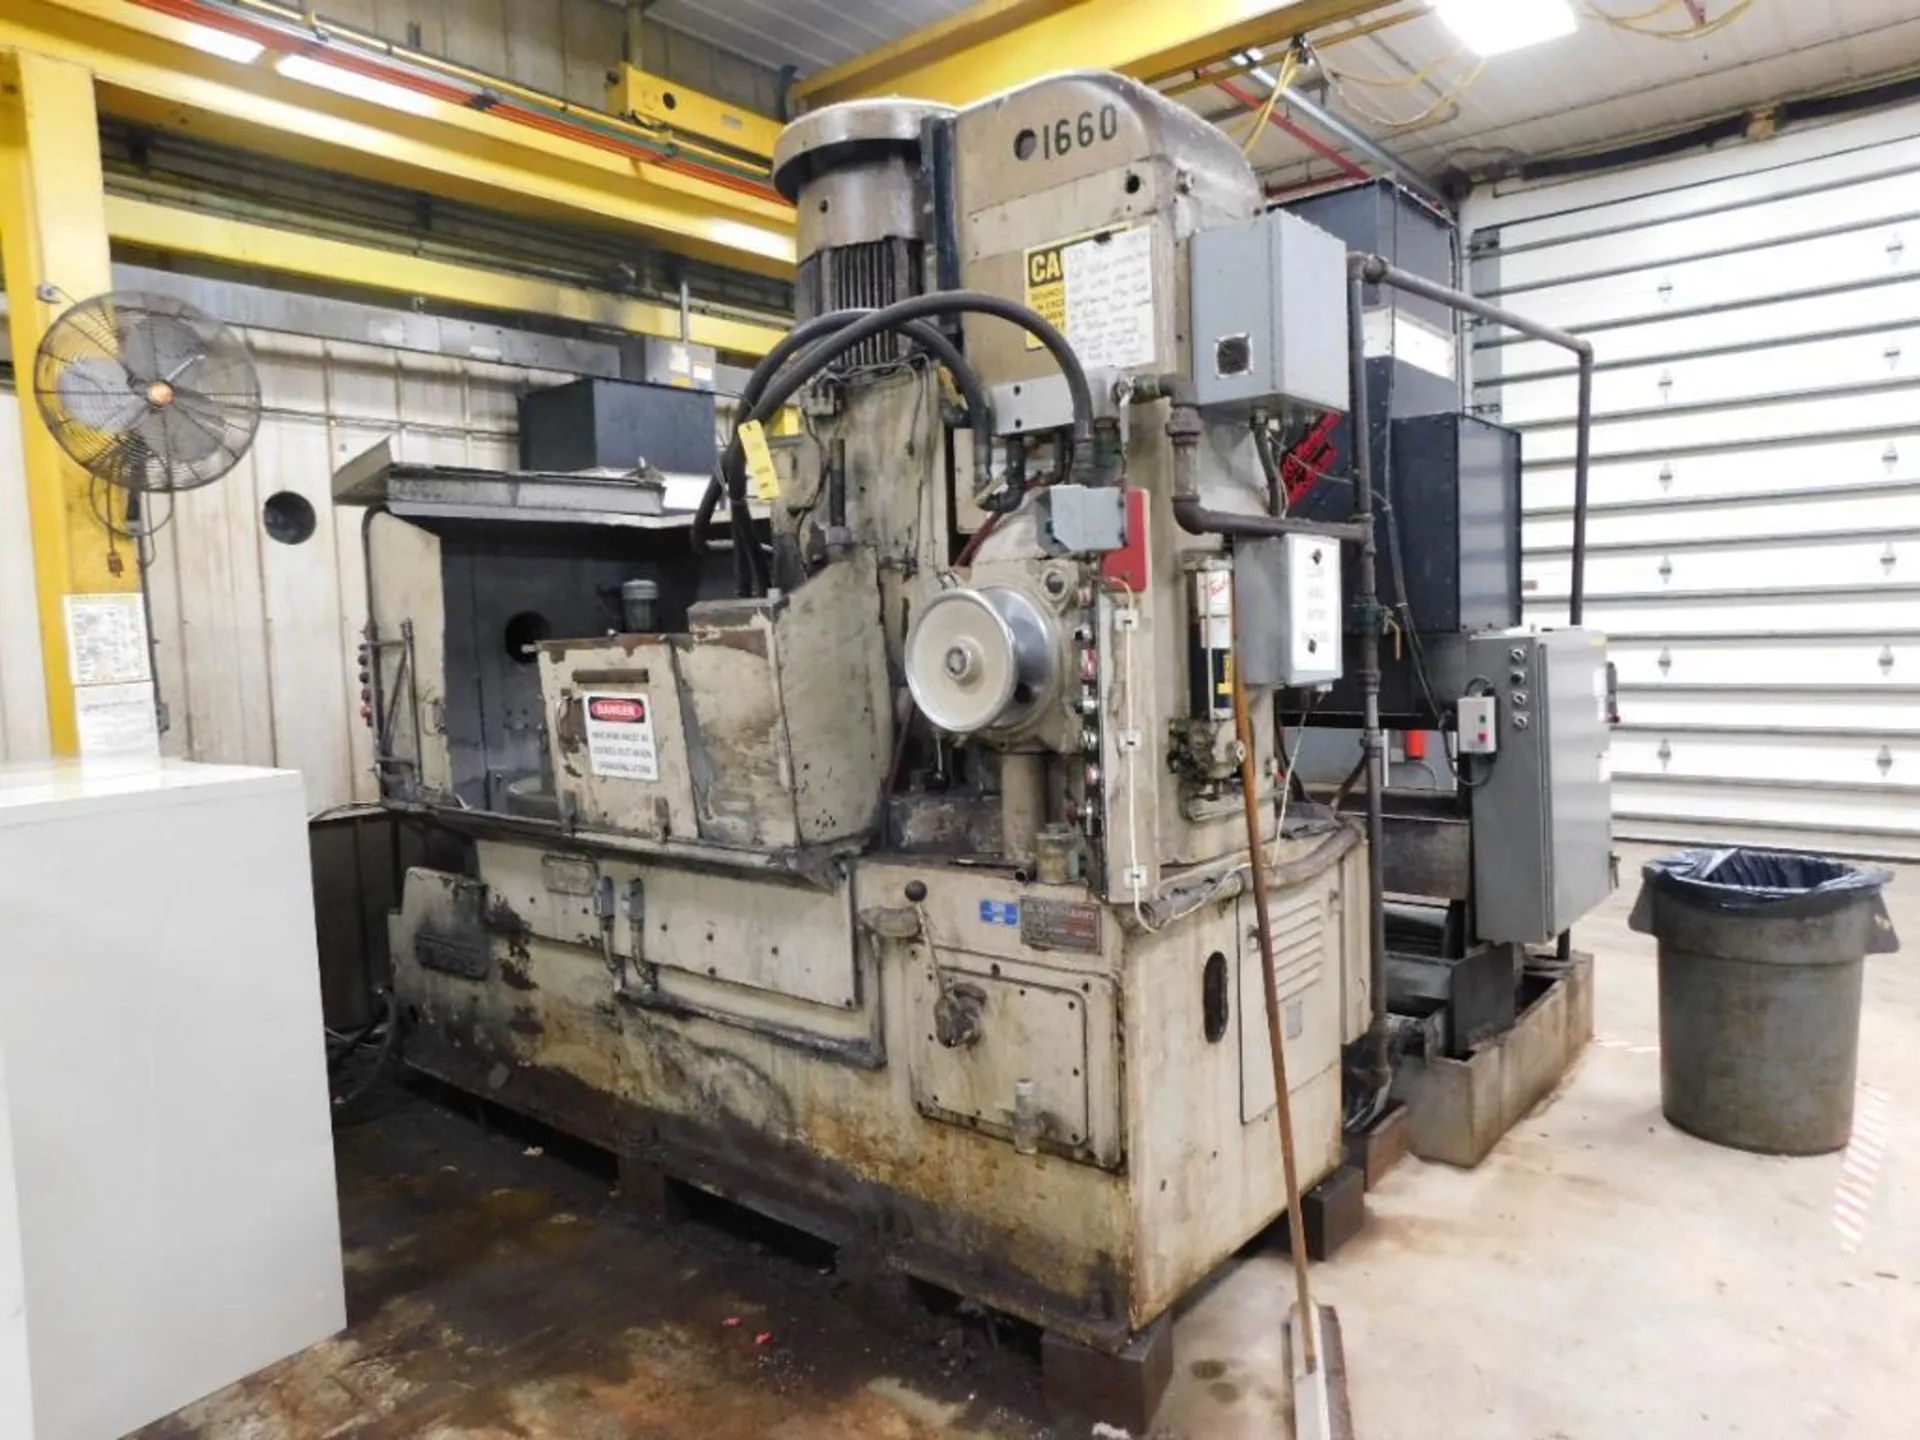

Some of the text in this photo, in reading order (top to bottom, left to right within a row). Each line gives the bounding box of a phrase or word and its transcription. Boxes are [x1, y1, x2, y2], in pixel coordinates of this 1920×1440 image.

[1043, 103, 1119, 160] 1660
[1031, 250, 1063, 284] CA
[596, 703, 635, 716] DANGER
